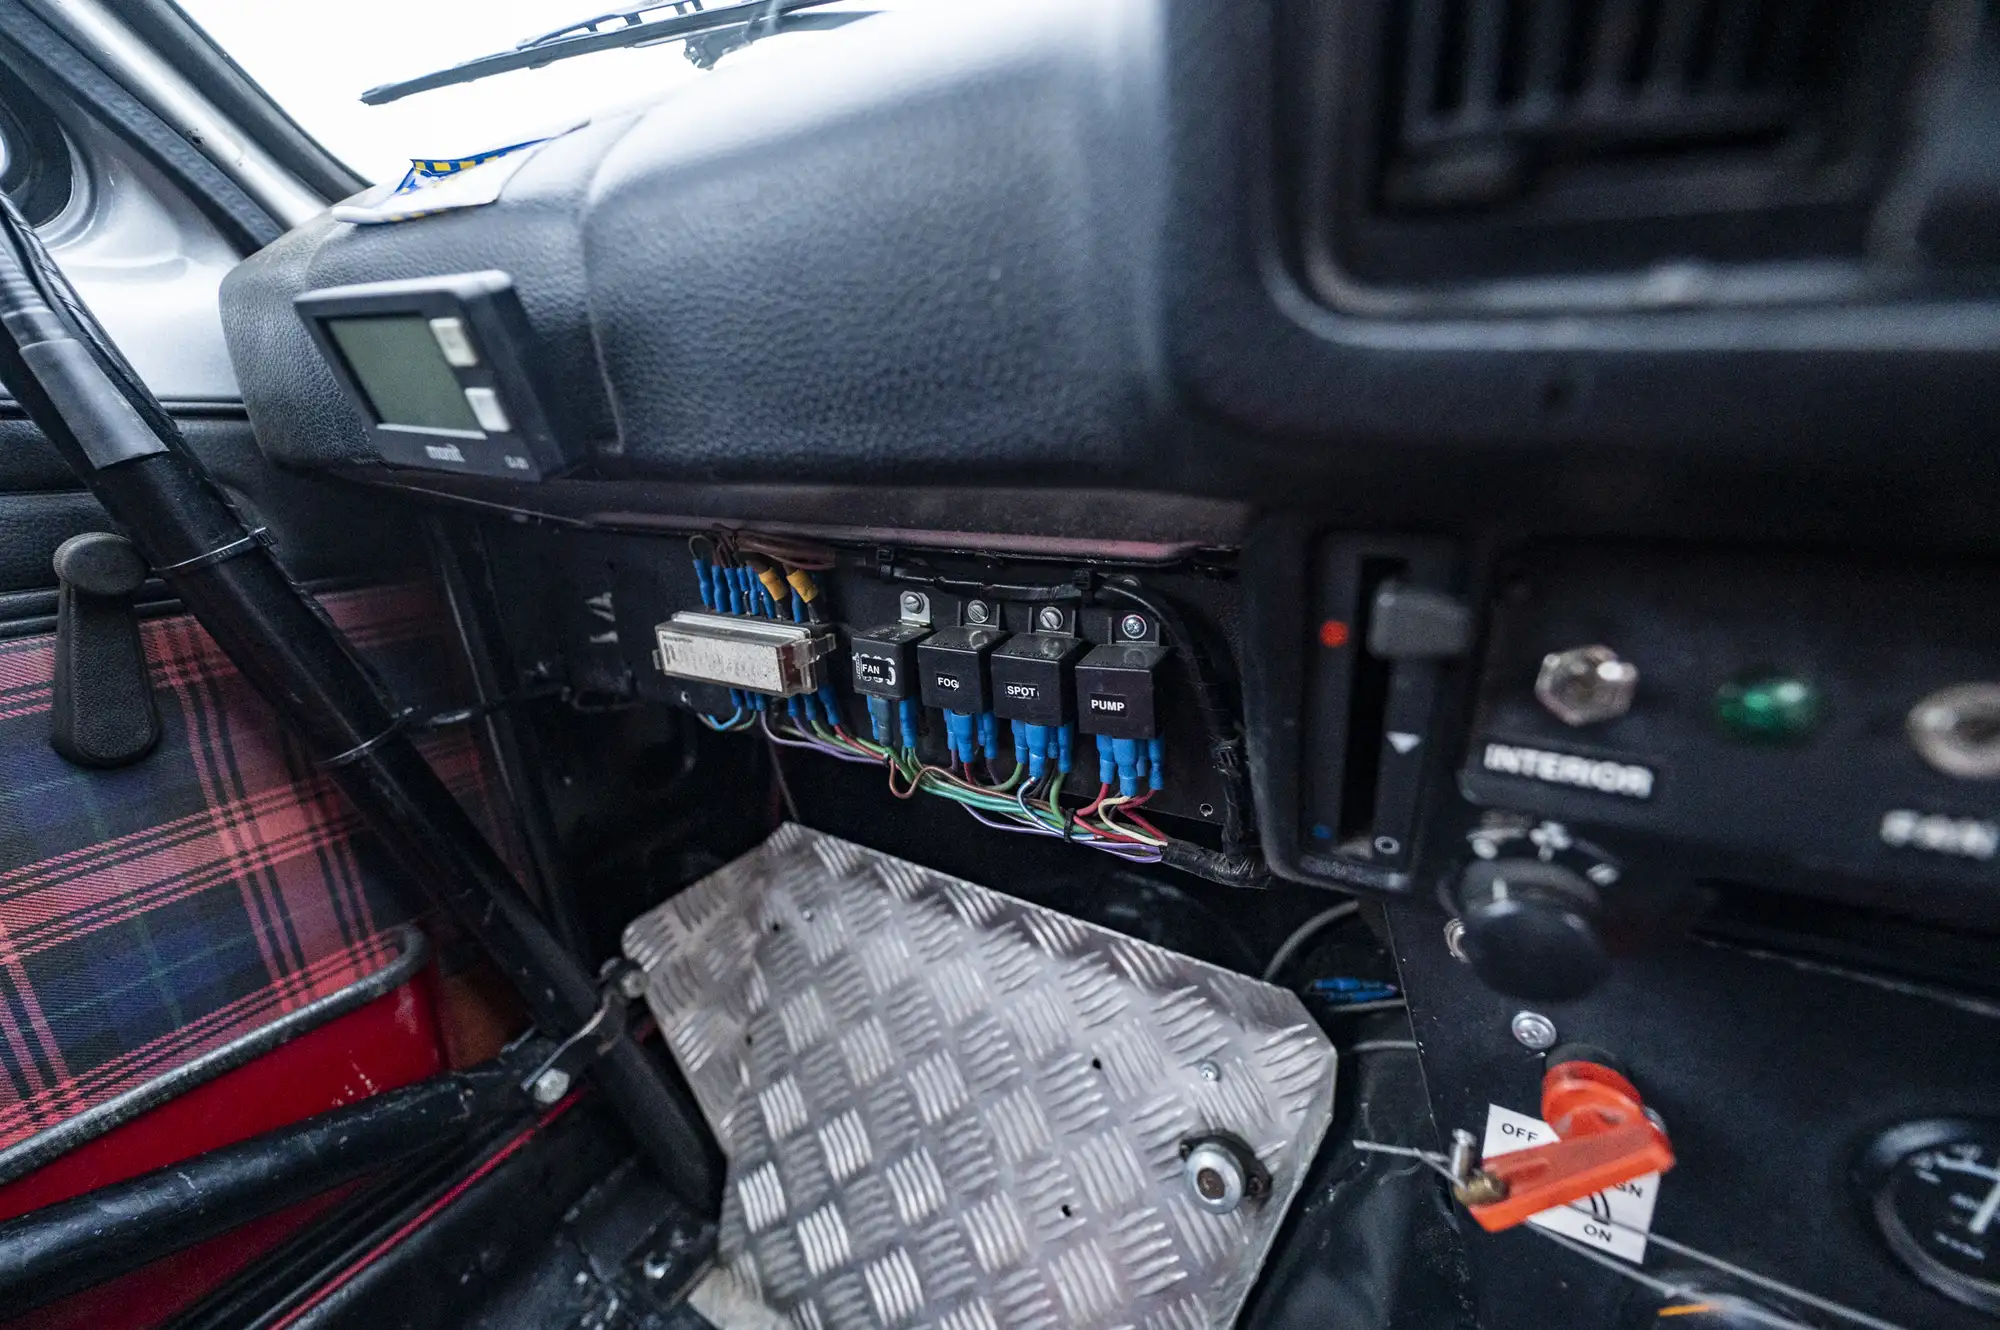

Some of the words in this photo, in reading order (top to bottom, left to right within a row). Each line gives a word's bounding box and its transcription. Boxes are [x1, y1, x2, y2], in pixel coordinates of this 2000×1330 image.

[862, 663, 880, 675] FAN
[937, 676, 959, 690] FOG
[1006, 685, 1036, 697] SPOT
[1091, 699, 1125, 712] PUMP
[1484, 743, 1654, 798] INTERIOR
[1502, 1122, 1538, 1142] OFF
[1583, 1223, 1612, 1243] ON
